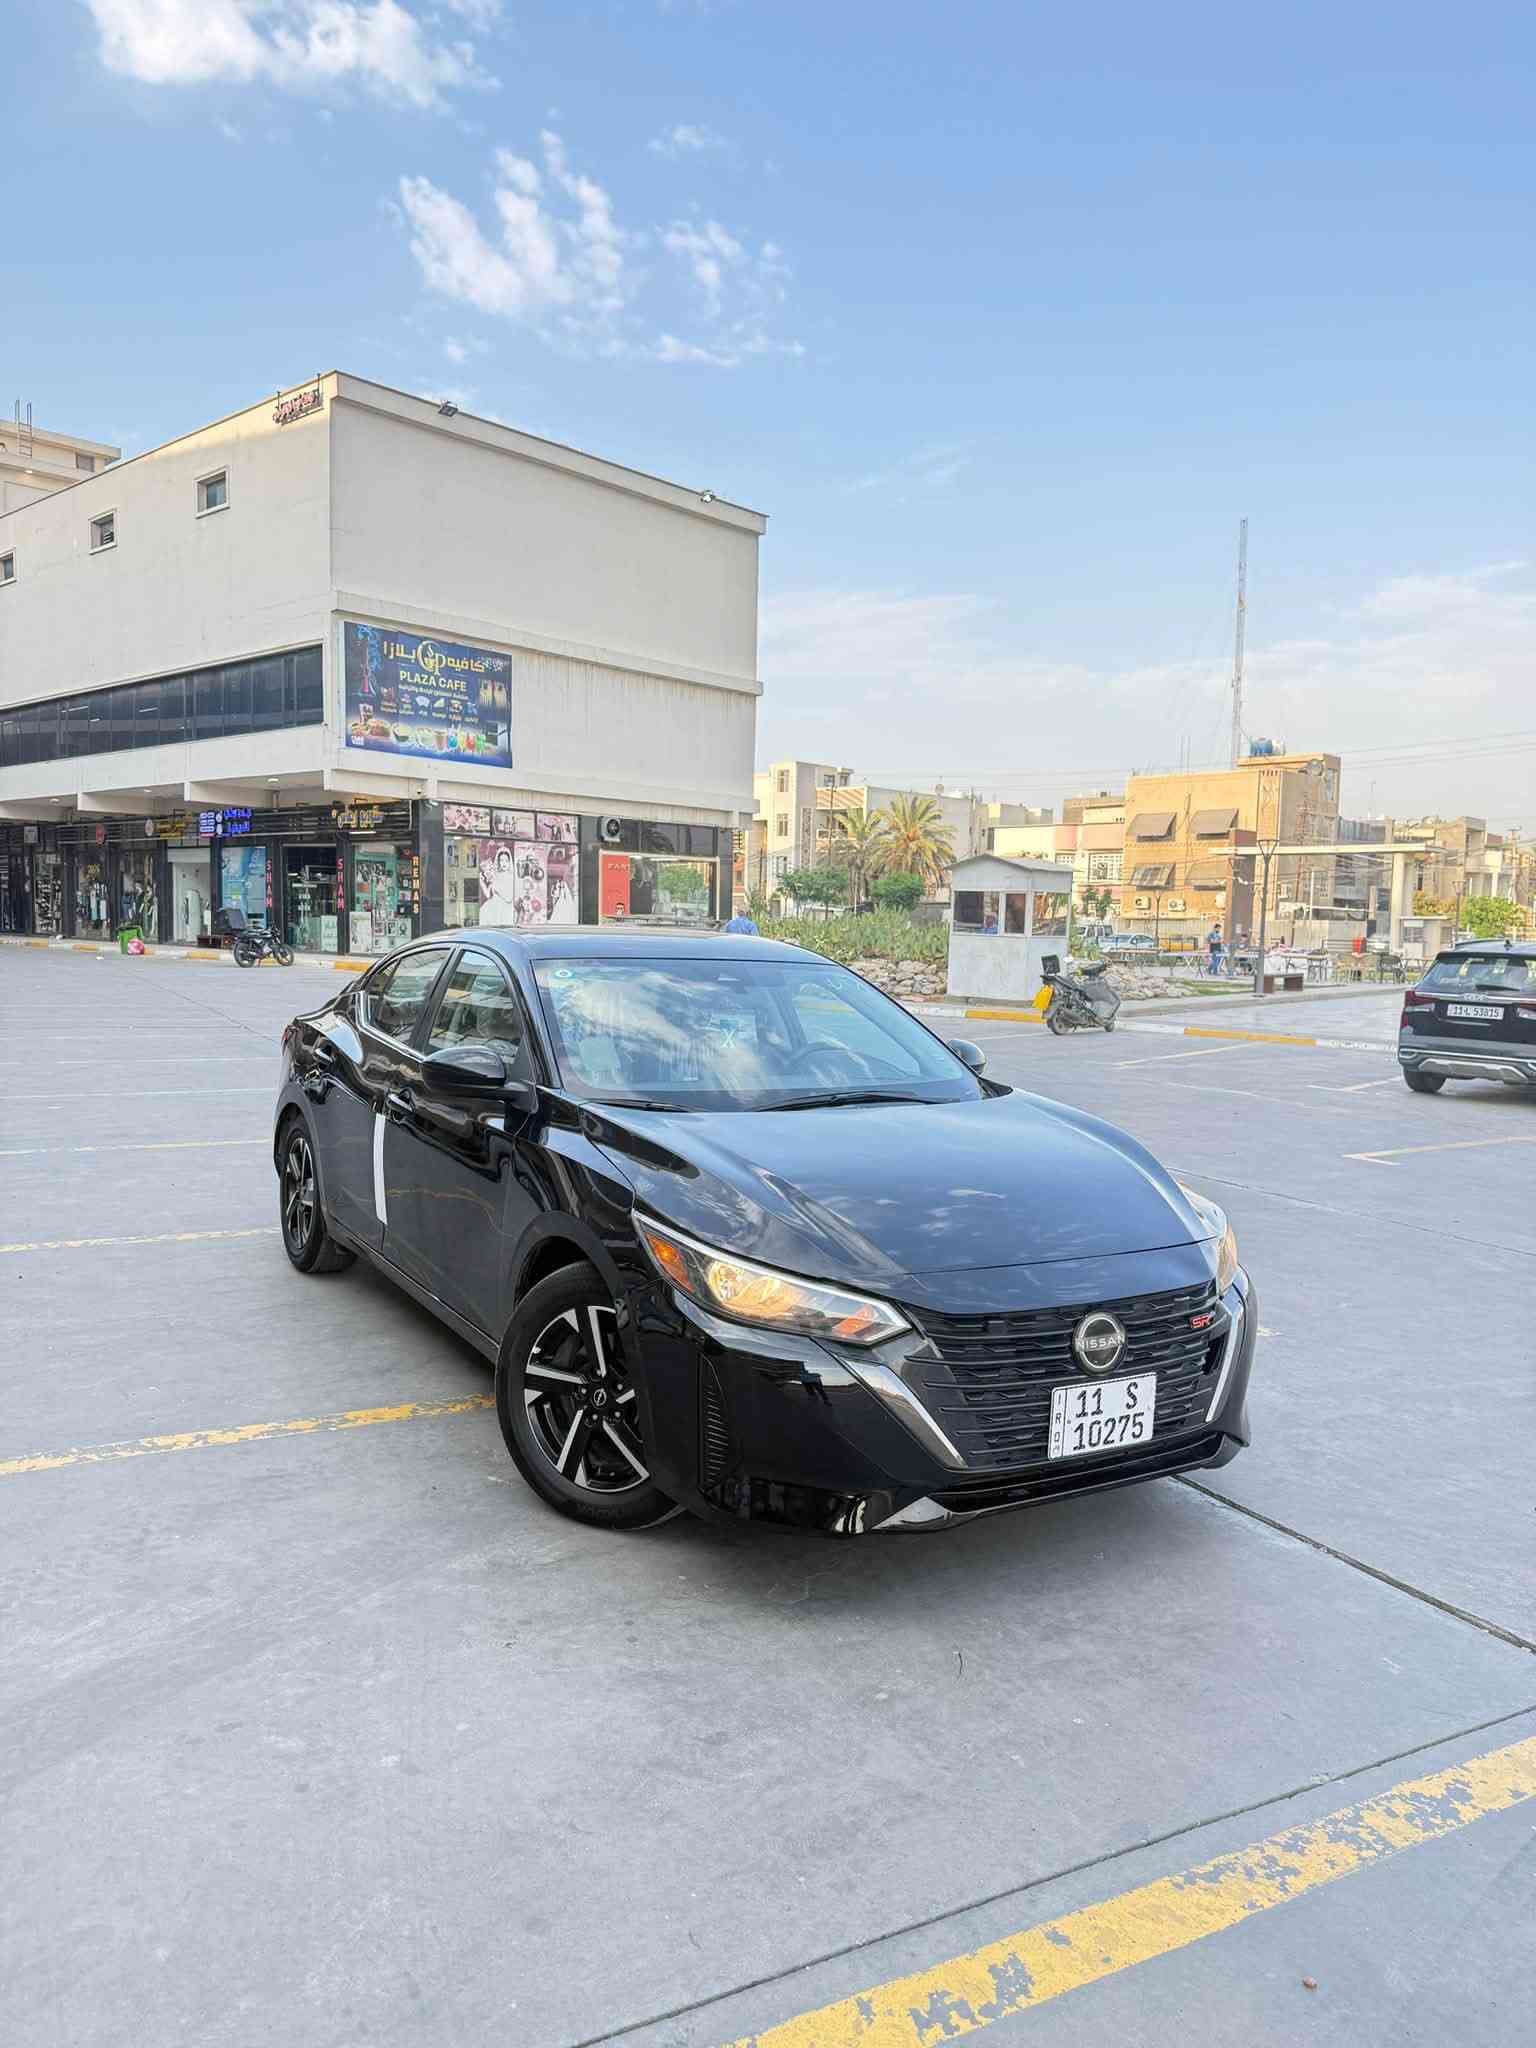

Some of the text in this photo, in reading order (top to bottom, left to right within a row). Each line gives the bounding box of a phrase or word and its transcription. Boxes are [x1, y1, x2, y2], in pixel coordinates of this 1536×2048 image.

[383, 640, 416, 663] بلازا
[447, 656, 485, 672] كافيه
[400, 670, 437, 687] PLAZA
[439, 677, 468, 692] CAFE
[336, 858, 344, 911] SHAM
[1075, 1334, 1125, 1350] NISSAN
[1076, 1382, 1138, 1418] 11 S
[1073, 1412, 1144, 1450] 10275
